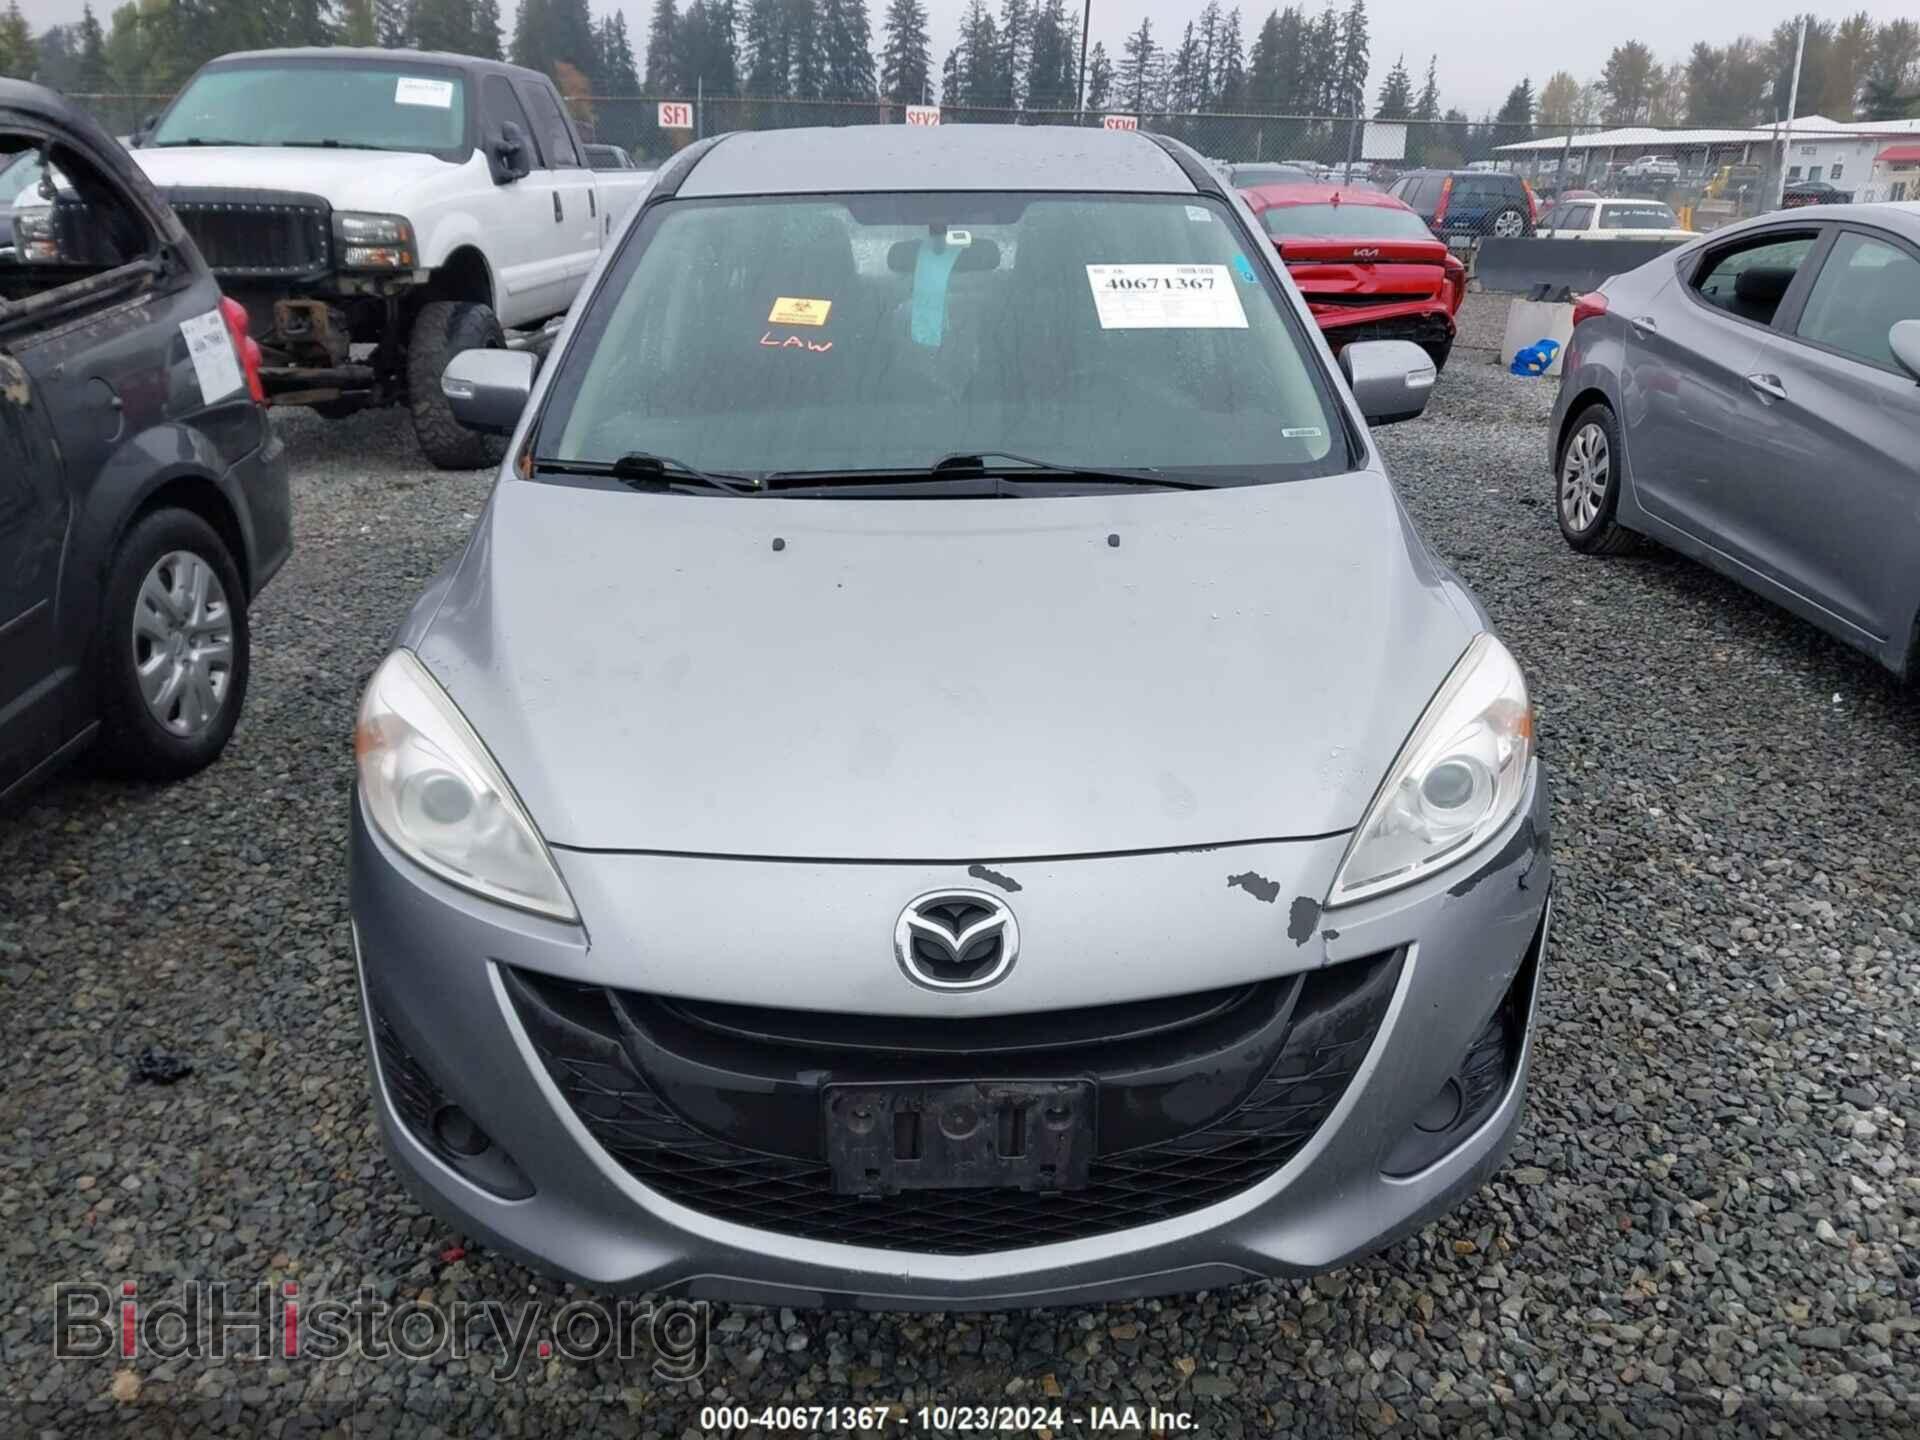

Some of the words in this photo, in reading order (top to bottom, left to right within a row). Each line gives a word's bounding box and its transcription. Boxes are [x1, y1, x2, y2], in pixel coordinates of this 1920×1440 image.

[663, 105, 688, 125] SF1
[1353, 248, 1379, 256] KIA
[1105, 278, 1214, 290] 40671367
[760, 331, 832, 352] LAW
